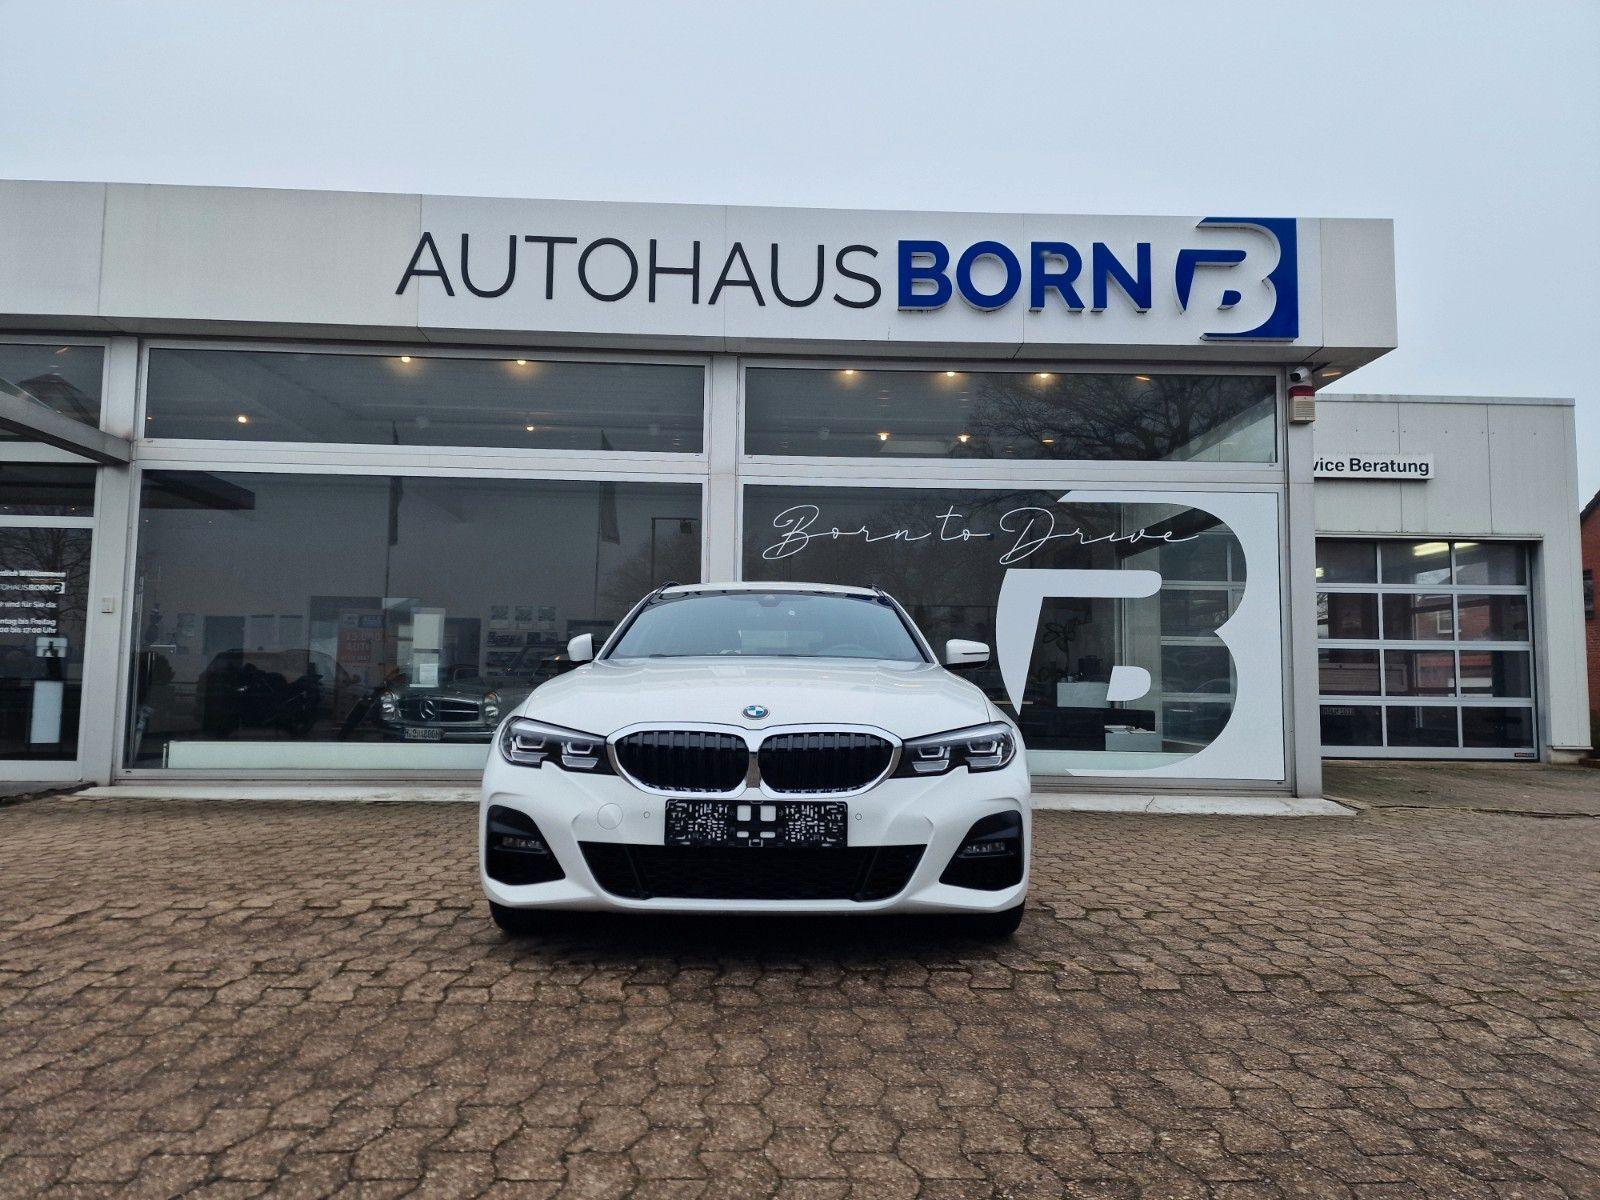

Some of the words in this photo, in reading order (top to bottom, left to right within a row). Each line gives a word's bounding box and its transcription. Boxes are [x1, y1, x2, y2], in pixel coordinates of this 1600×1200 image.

[1350, 458, 1430, 476] Beratung
[763, 504, 931, 560] Born
[935, 505, 991, 542] to
[999, 507, 1200, 565] Drive
